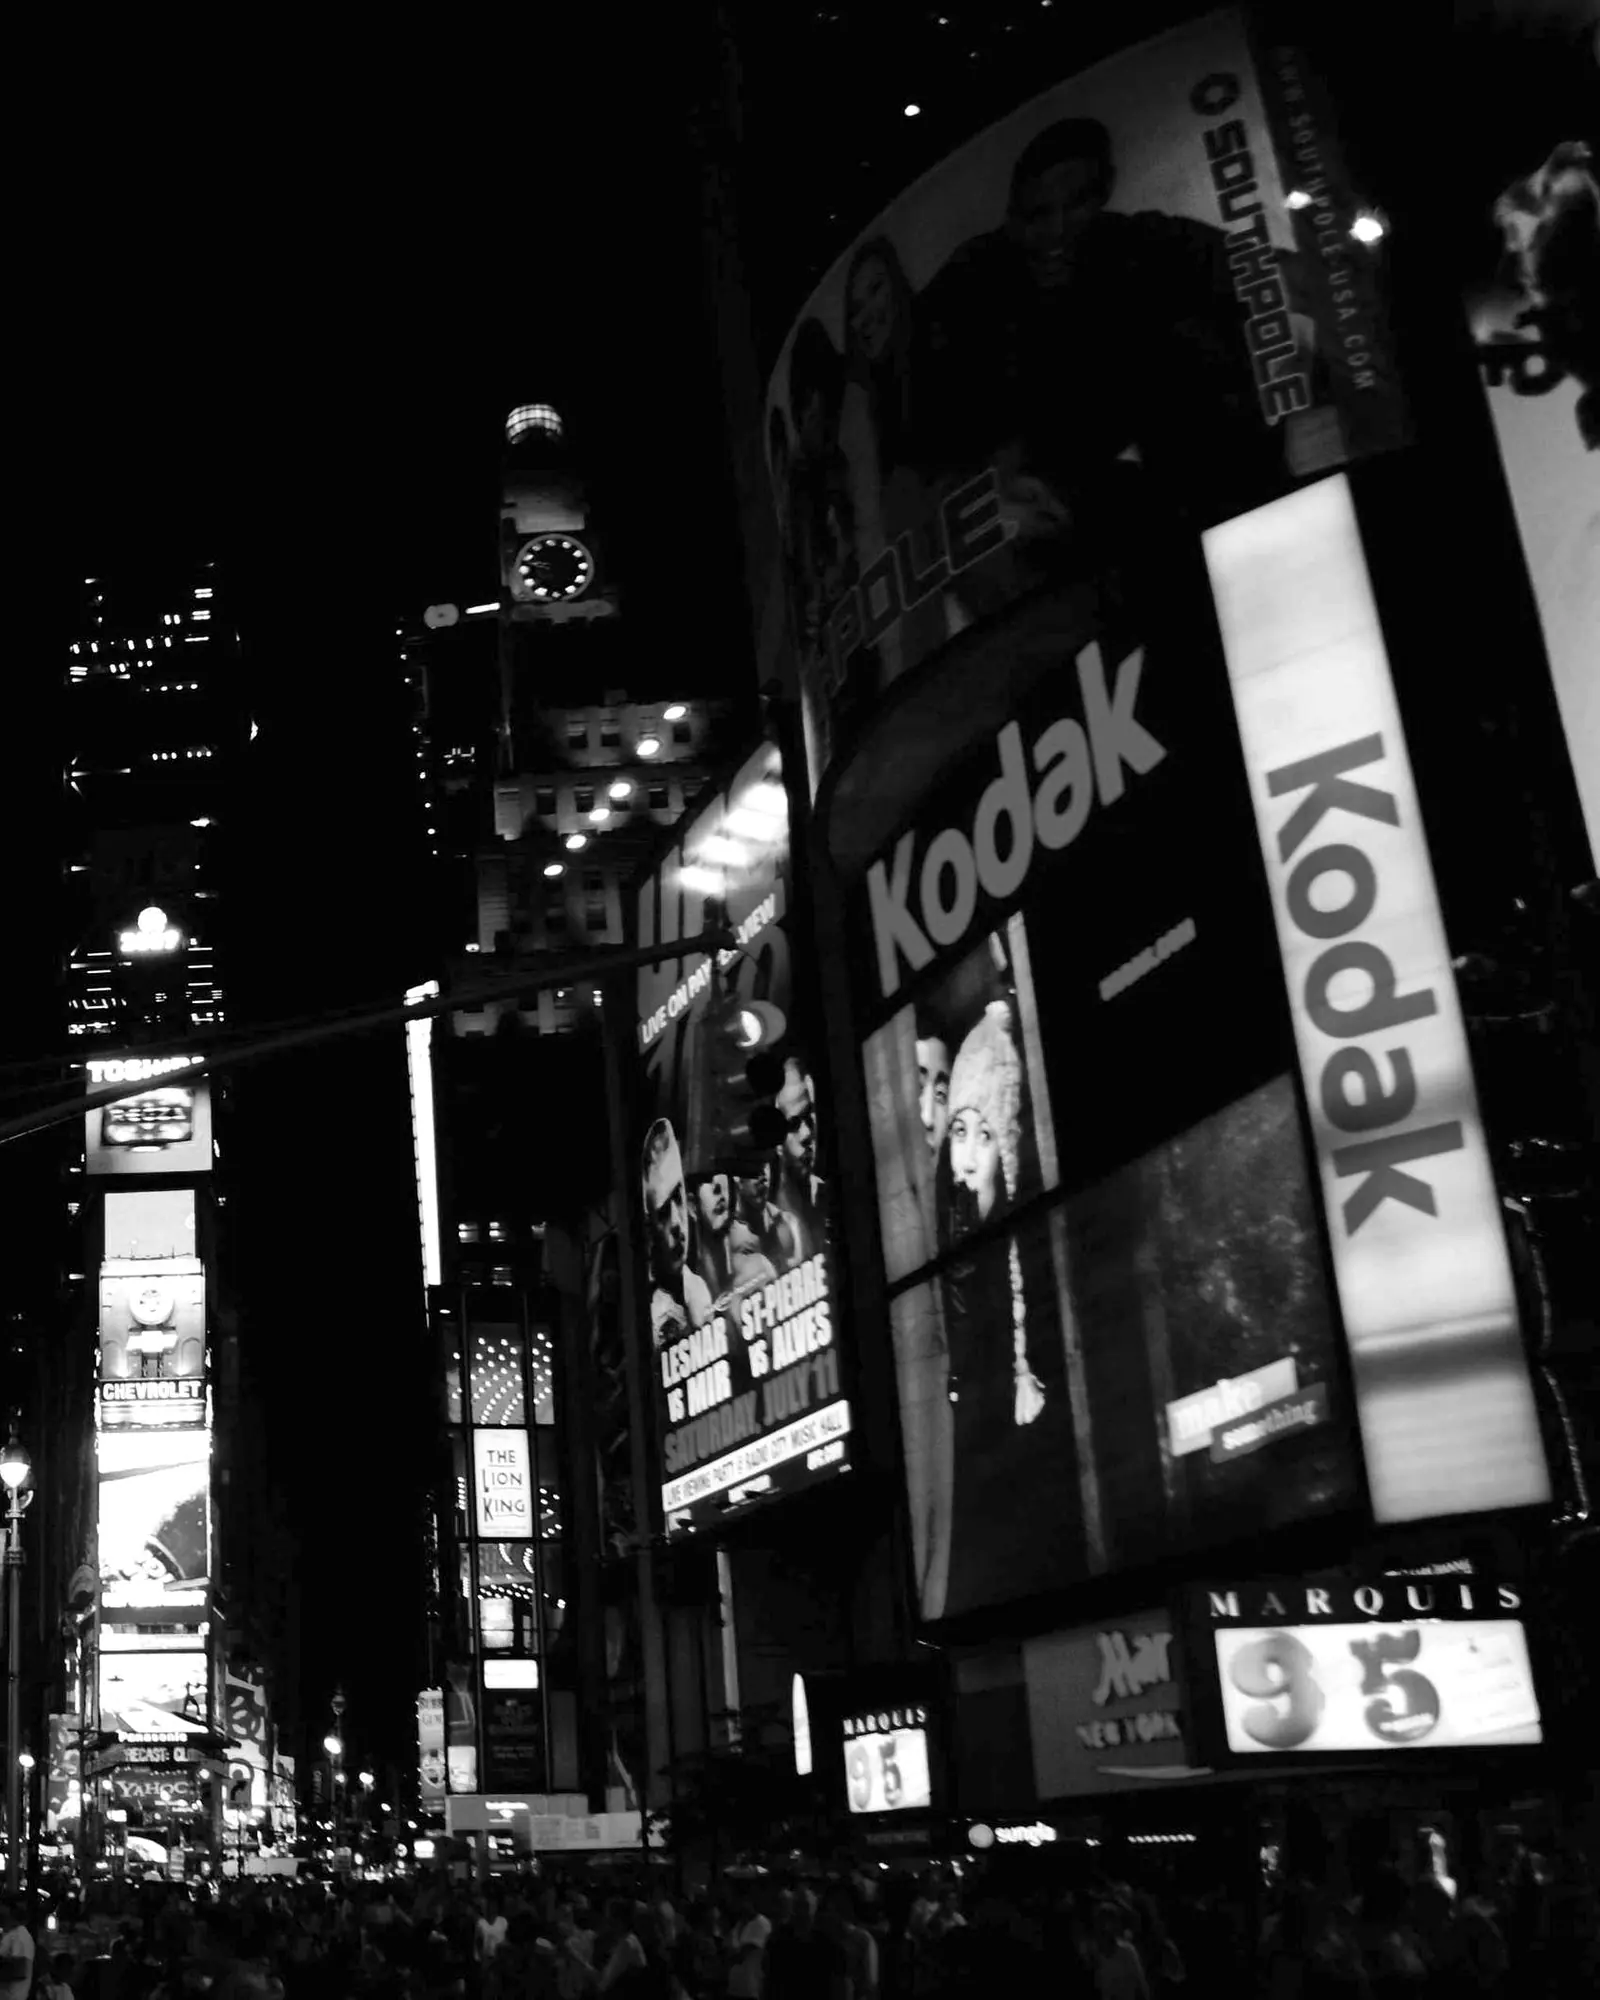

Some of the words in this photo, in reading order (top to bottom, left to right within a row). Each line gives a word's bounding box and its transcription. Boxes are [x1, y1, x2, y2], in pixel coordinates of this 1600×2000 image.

[1203, 118, 1312, 427] SOUTHPOLE
[866, 638, 1169, 1000] Kodak
[1265, 730, 1465, 1238] Kodak
[661, 1316, 729, 1388] LESNAR
[771, 1300, 832, 1371] ALVES
[102, 1380, 202, 1400] CHEVROLET
[686, 1359, 733, 1418] MIR
[486, 1450, 517, 1464] THE
[482, 1468, 523, 1493] LION
[483, 1498, 526, 1522] KING
[1208, 1584, 1521, 1618] MARQUIS
[843, 1706, 928, 1736] MARQUIS
